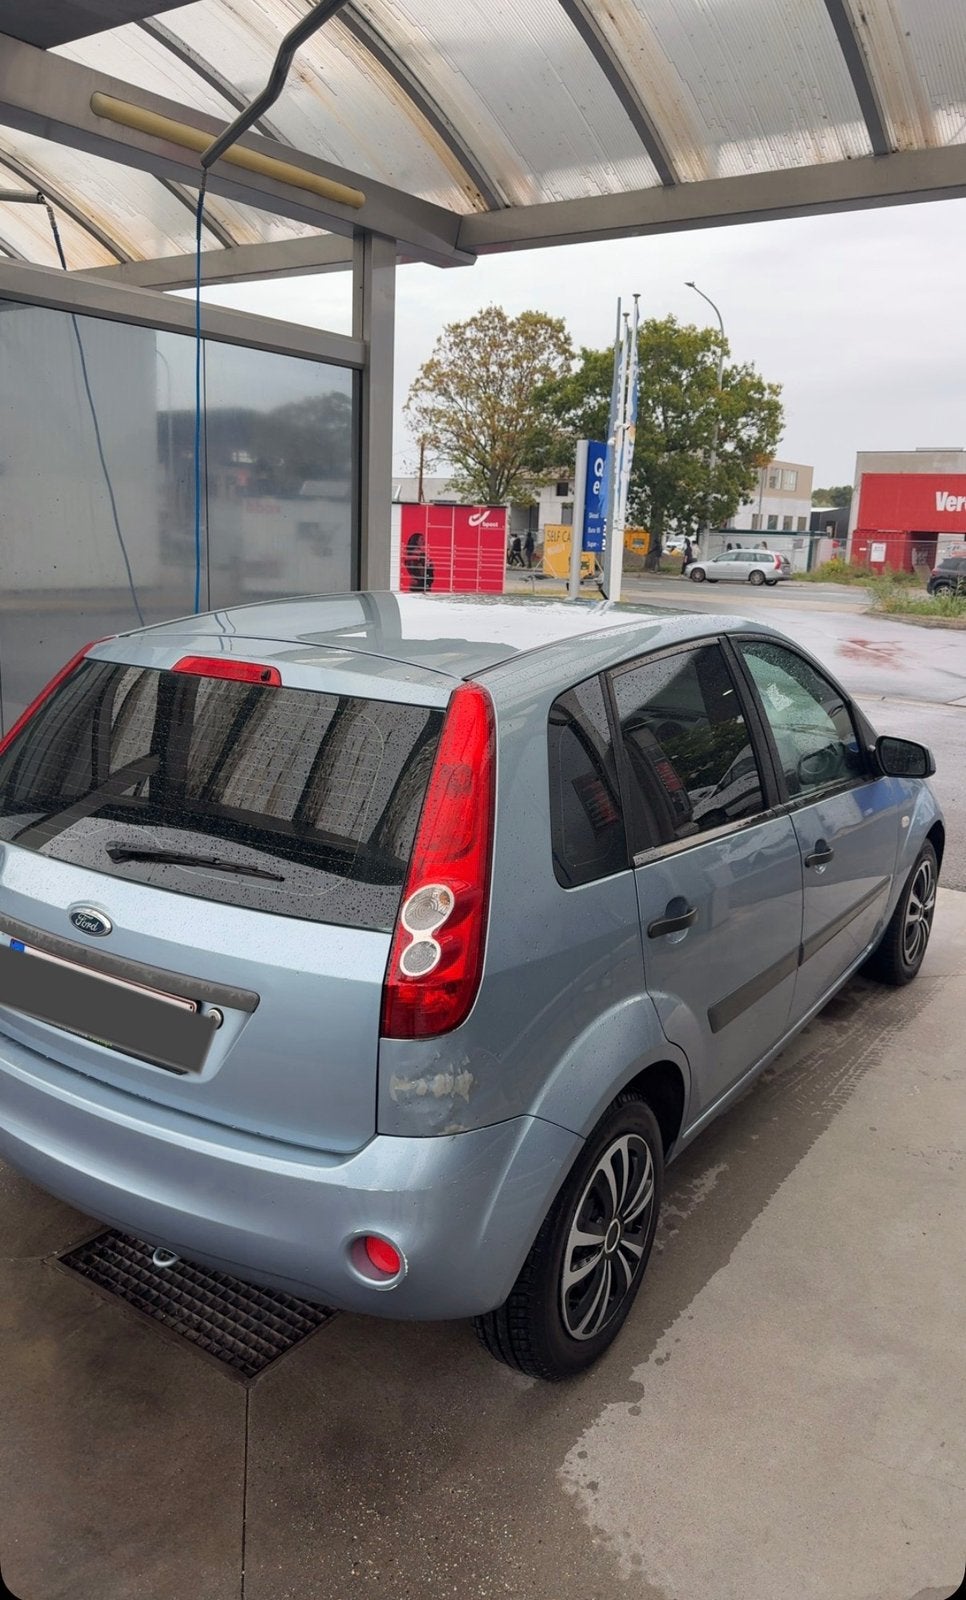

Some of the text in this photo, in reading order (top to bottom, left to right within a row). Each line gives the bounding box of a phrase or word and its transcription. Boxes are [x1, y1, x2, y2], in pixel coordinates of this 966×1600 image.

[594, 457, 604, 477] Q
[547, 530, 571, 542] SELF CA
[76, 913, 98, 931] Ford
